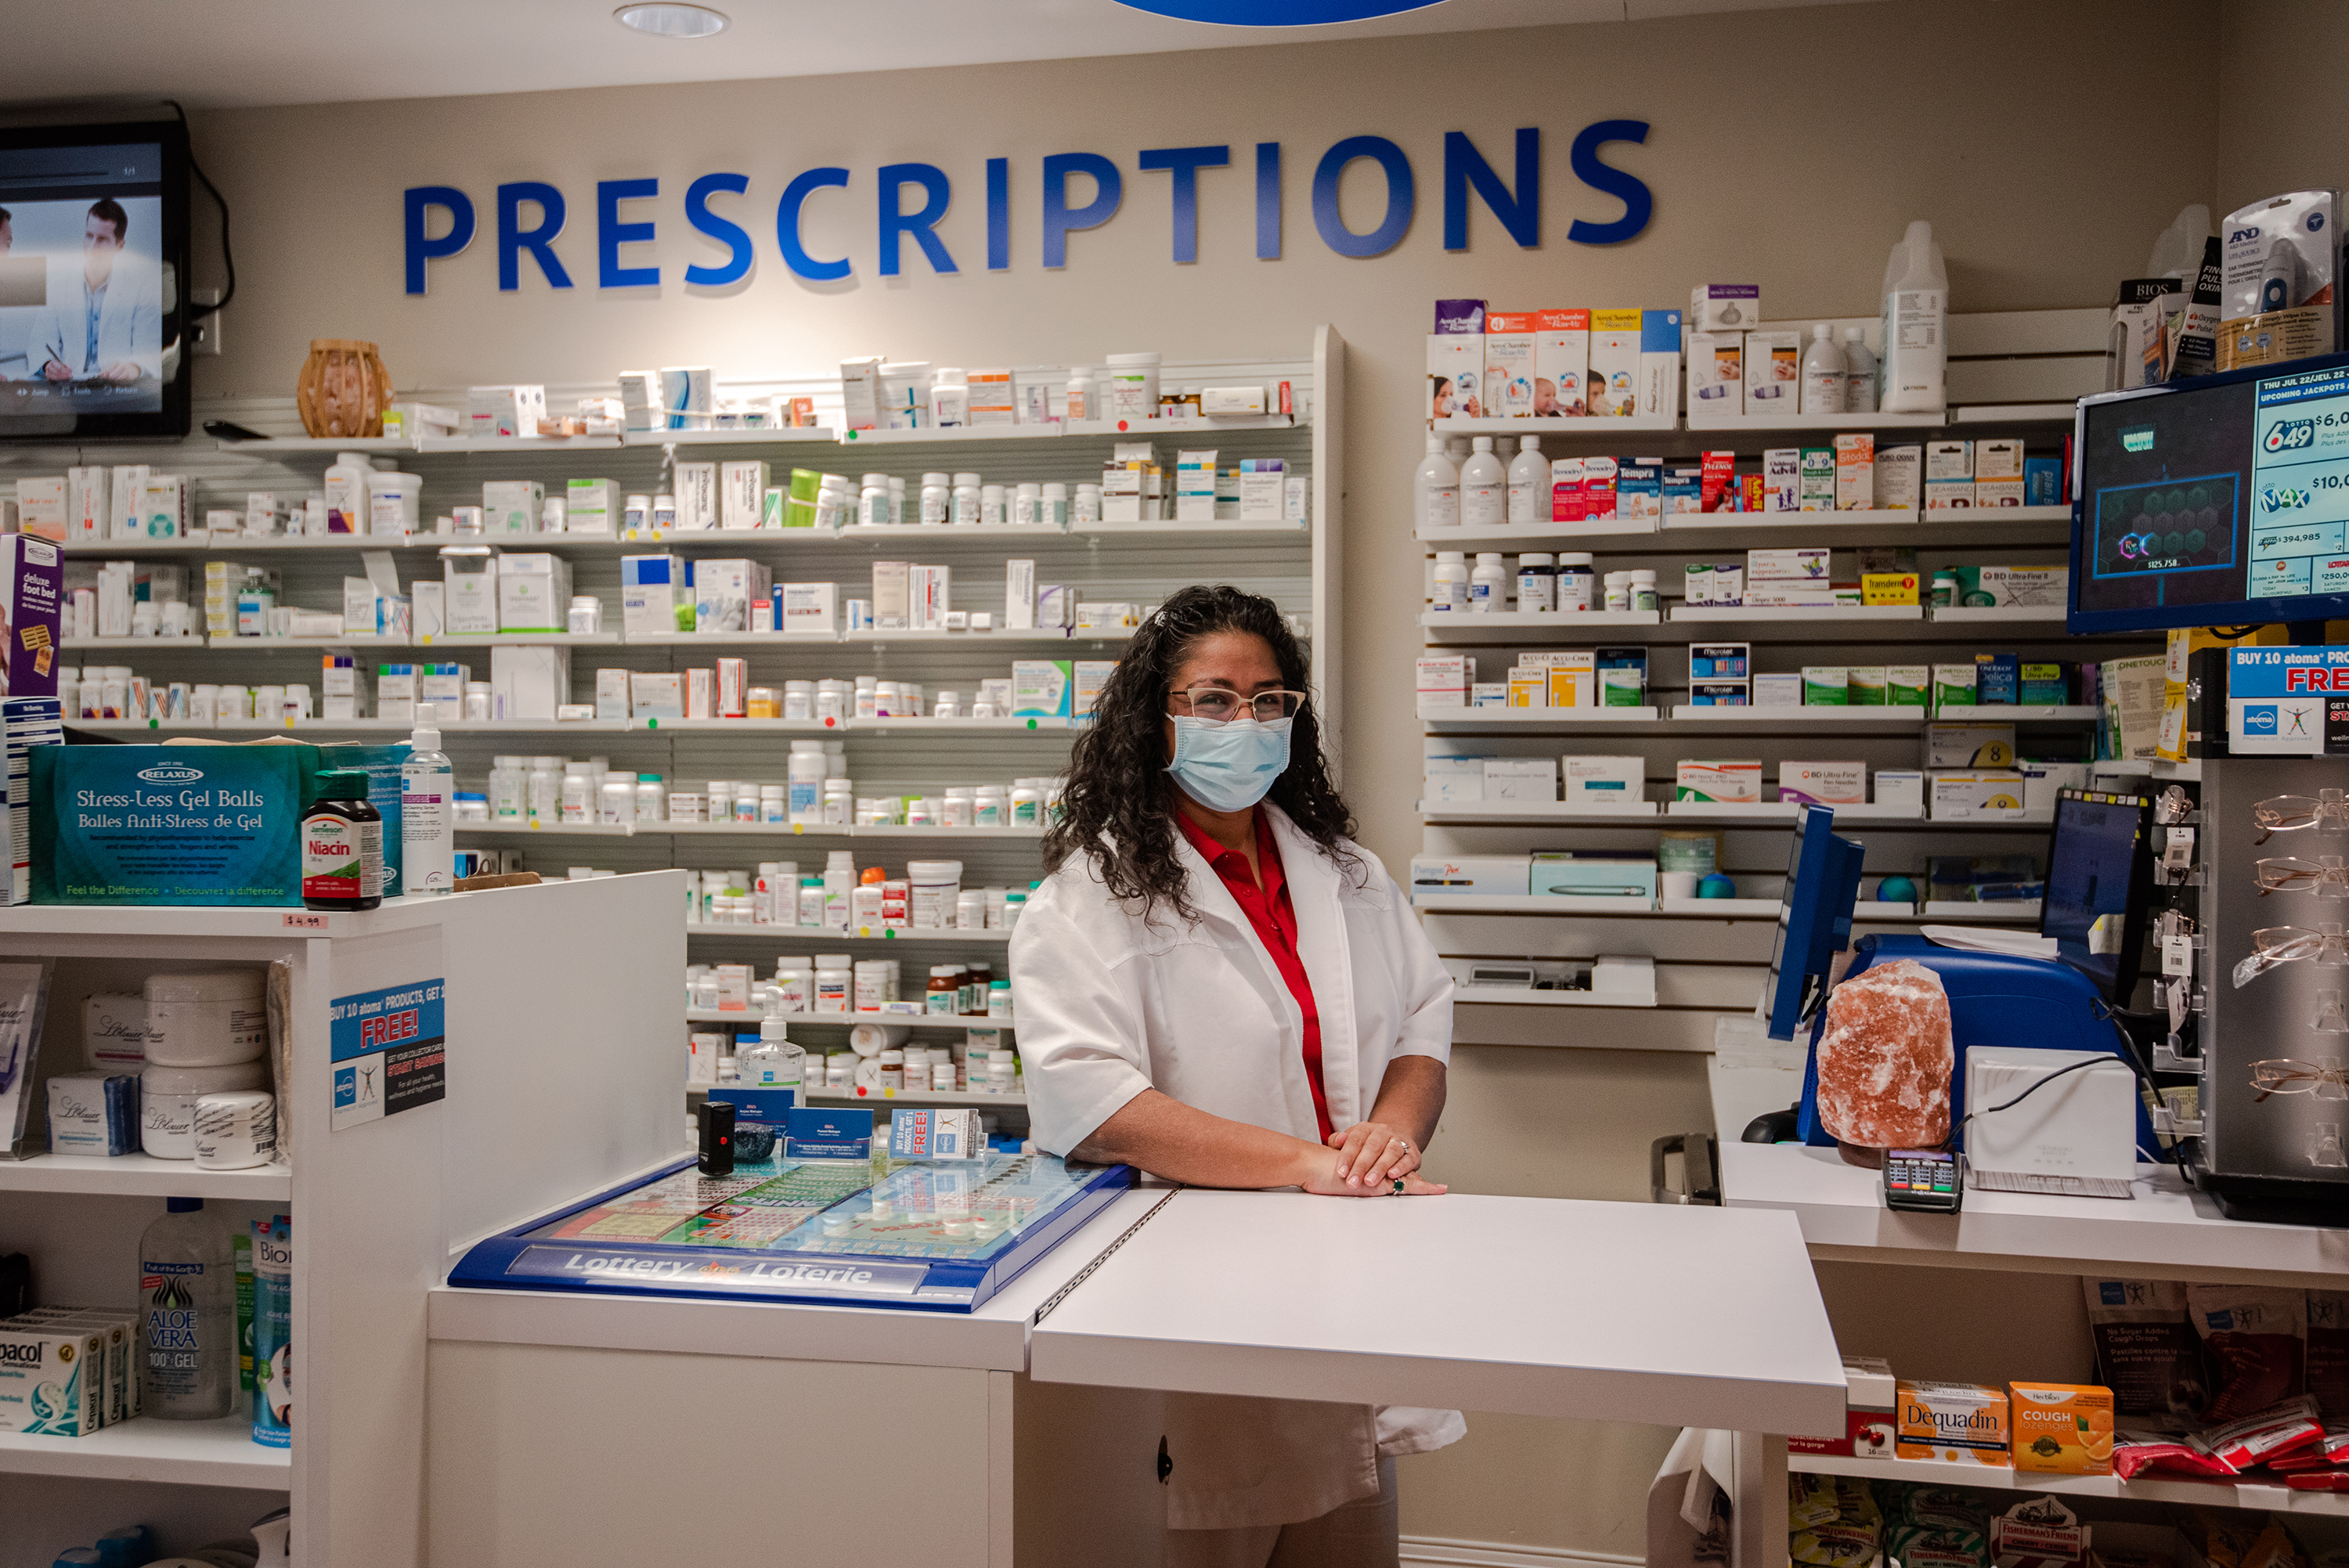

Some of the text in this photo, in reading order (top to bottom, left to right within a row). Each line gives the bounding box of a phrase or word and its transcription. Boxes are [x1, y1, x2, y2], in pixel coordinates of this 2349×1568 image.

[403, 120, 1653, 295] PRESCRIPTIONS
[2240, 239, 2258, 248] Medical
[2136, 283, 2169, 296] BIOS
[1541, 313, 1586, 322] AeroChamber
[2198, 313, 2221, 324] Oxygen
[2196, 323, 2213, 333] Pulse
[2264, 381, 2280, 390] THU
[2300, 373, 2332, 384] 22/JEU.
[2261, 383, 2345, 402] UPCOMING JACKPOTS
[1839, 452, 1871, 463] Stodal
[1619, 467, 1654, 480] Tempra
[1703, 463, 1733, 471] TYLENOL
[1770, 467, 1798, 476] Advil
[1664, 476, 1690, 485] Tempra
[2044, 470, 2054, 494] plan
[2259, 481, 2275, 493] Lotto
[2261, 488, 2310, 513] MAX
[23, 572, 50, 587] deluxe
[1869, 579, 1912, 588] Transderm V
[23, 583, 56, 599] foot bed
[1703, 647, 1733, 656] Microlet
[2237, 652, 2281, 665] BUY 10
[146, 770, 197, 780] RELAXUS
[77, 790, 264, 811] Stress-Less Gel Balls
[78, 814, 263, 831] Balles Anti-Stress de Gel
[311, 824, 343, 834] Jamieson
[309, 840, 350, 856] Niacin
[1444, 863, 1460, 876] Pen
[67, 885, 160, 896] Feel the Difference
[226, 887, 235, 896] la
[330, 986, 440, 1021] BUY 10 PRODUCTS, GET
[361, 1008, 419, 1049] FREE!
[388, 1043, 443, 1064] GET YOUR COLLECTOR CARD
[388, 1060, 414, 1077] START
[336, 1083, 354, 1092] atoma
[413, 1078, 423, 1087] your
[903, 1116, 914, 1154] PRODUCTS, GET
[913, 1112, 928, 1155] FREE!
[896, 1132, 904, 1150] BUY 10
[565, 1254, 695, 1278] Lottery
[750, 1263, 873, 1284] Loterie
[148, 1309, 197, 1329] ALOE
[149, 1329, 198, 1348] VERA
[175, 1353, 198, 1368] GEL
[111, 1383, 121, 1421] Cepacol
[86, 1392, 97, 1430] Cepacol
[2022, 1411, 2071, 1422] COUGH
[1907, 1405, 1997, 1432] Dequadin
[2020, 1419, 2073, 1433] lozenges
[2003, 1524, 2078, 1541] FISHERMAN'S FRIEND
[2012, 1537, 2038, 1546] CHERRY
[1909, 1550, 1976, 1564] FISHERMAN'S FRIEND
